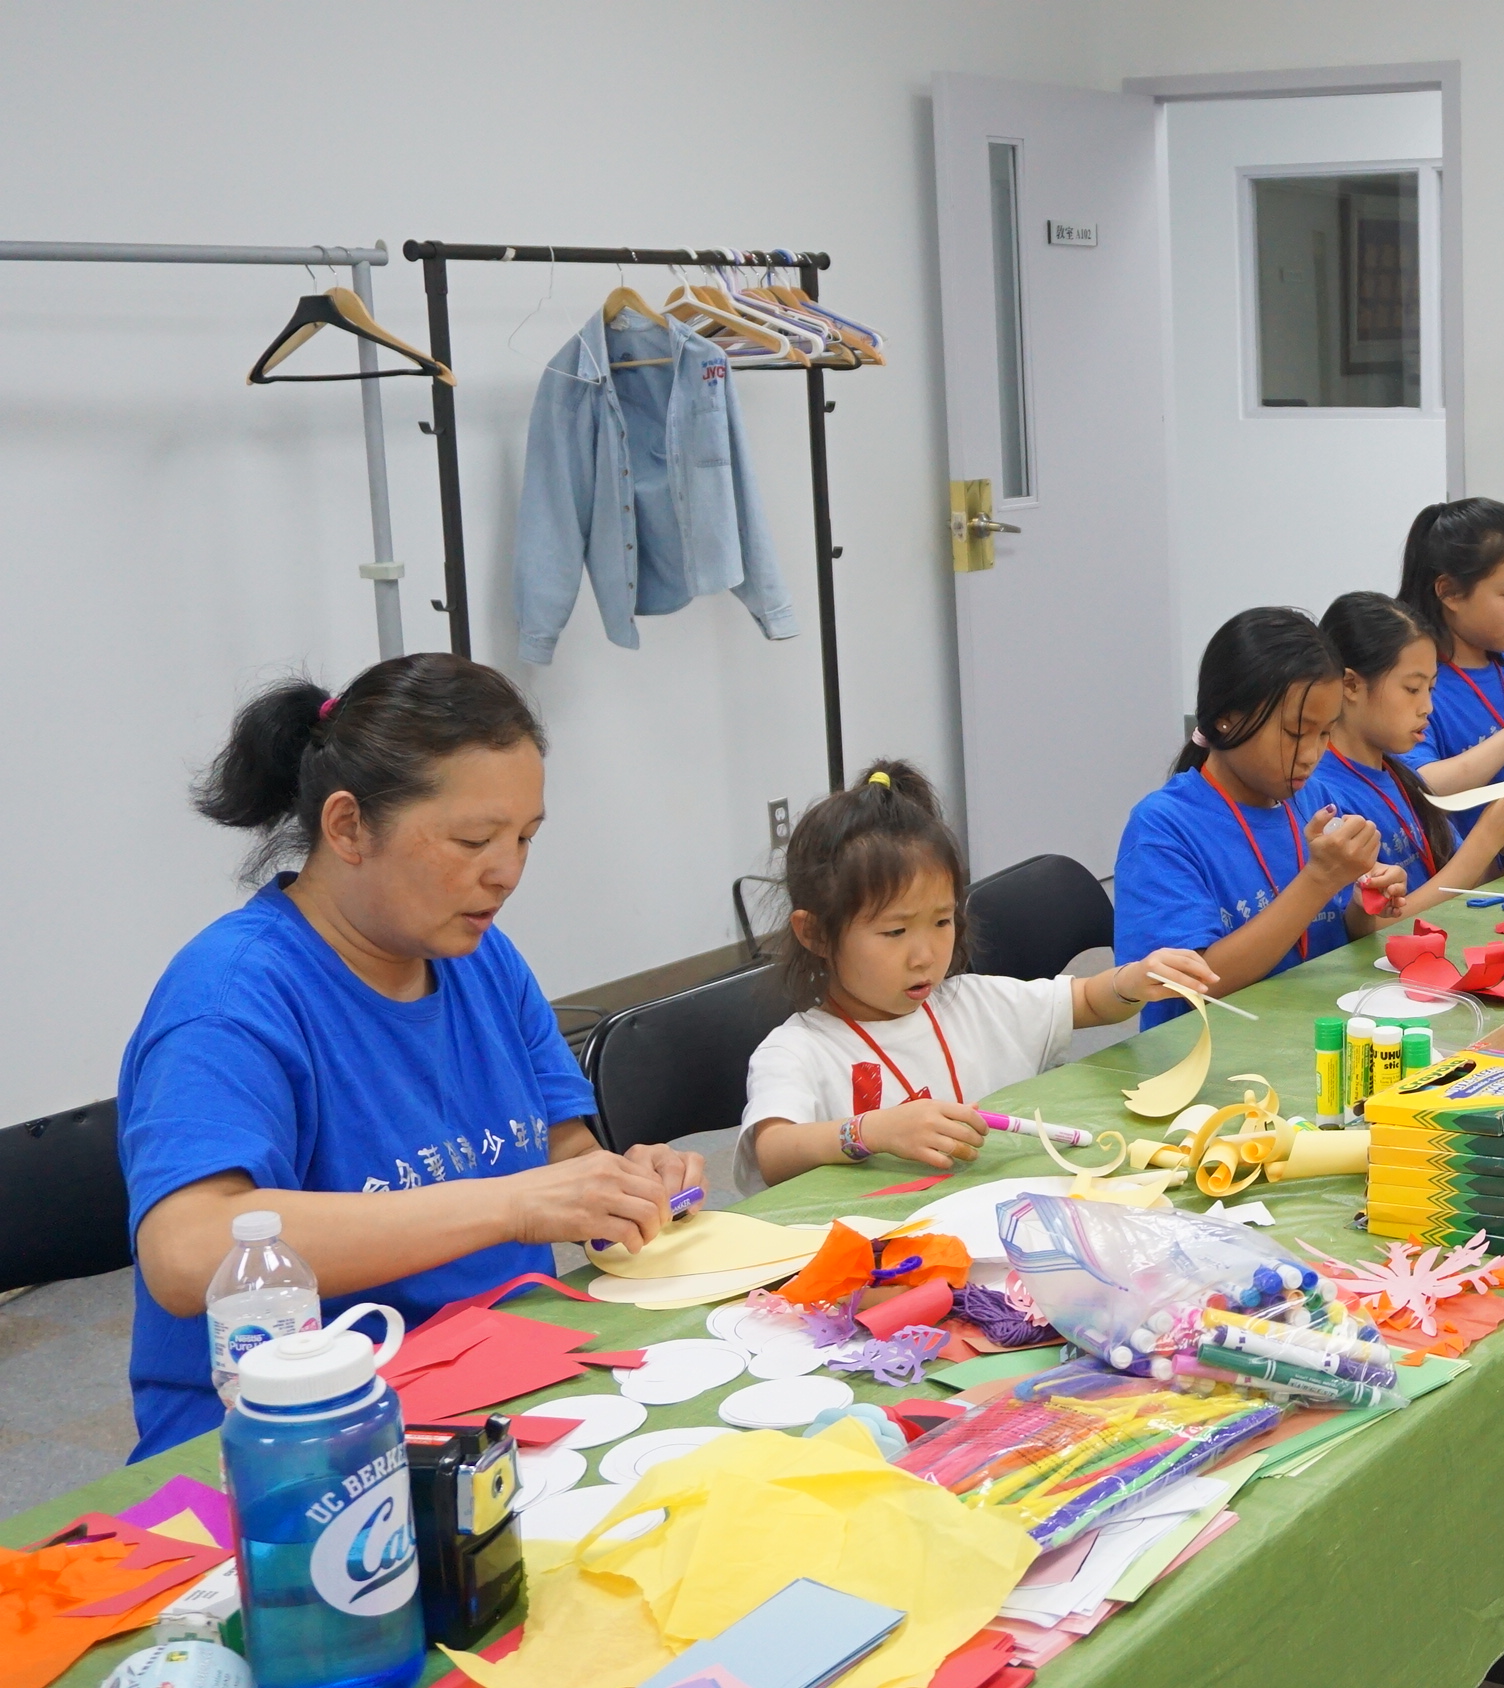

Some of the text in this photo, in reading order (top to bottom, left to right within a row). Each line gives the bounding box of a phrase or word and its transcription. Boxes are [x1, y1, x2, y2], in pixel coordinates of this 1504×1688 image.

[1056, 225, 1074, 240] 教室
[1380, 1050, 1400, 1060] UHU
[1398, 1057, 1467, 1092] Crayola
[229, 1341, 254, 1351] Pure
[305, 1492, 344, 1524] UC
